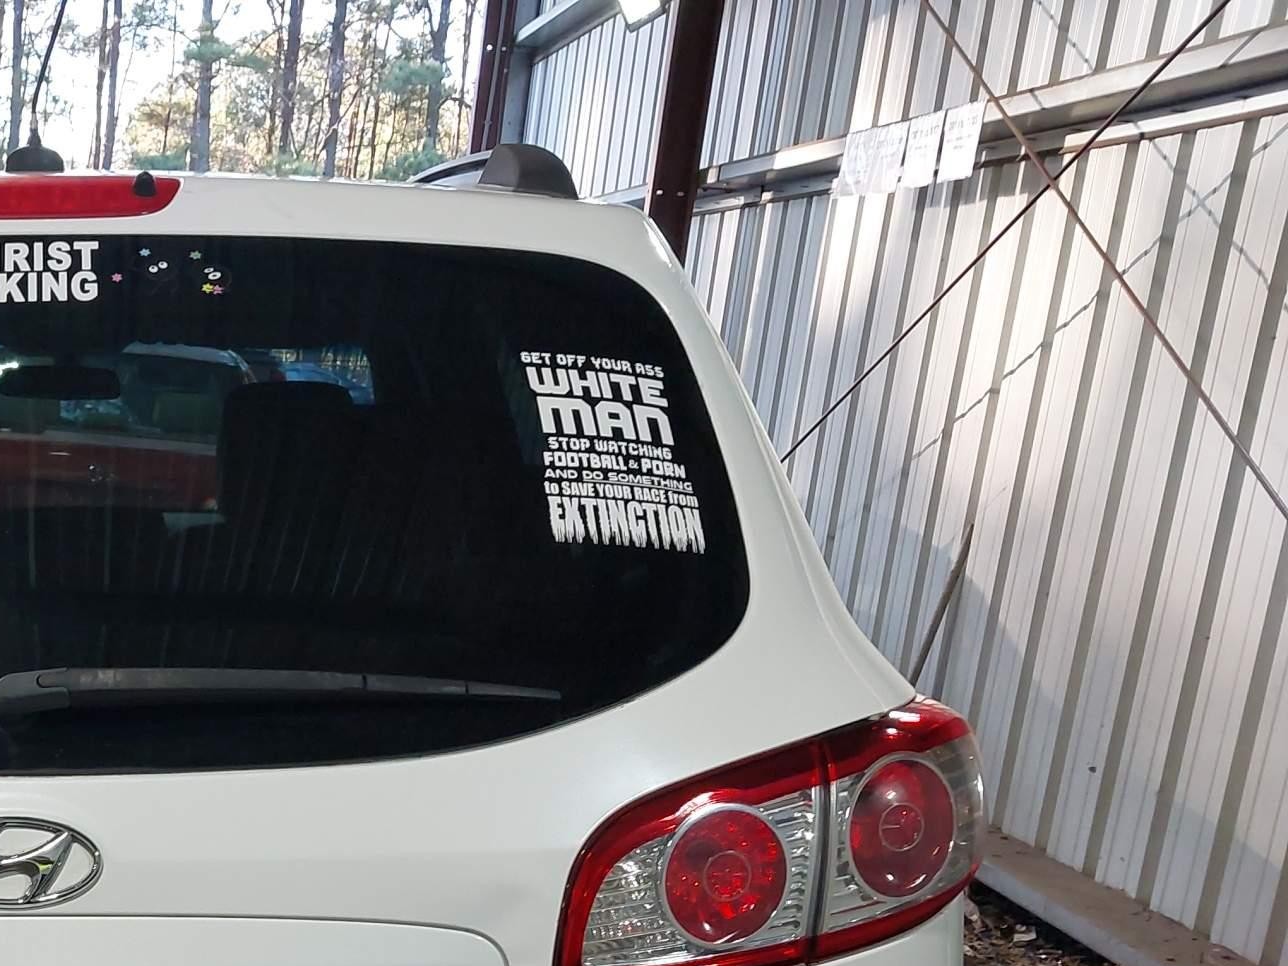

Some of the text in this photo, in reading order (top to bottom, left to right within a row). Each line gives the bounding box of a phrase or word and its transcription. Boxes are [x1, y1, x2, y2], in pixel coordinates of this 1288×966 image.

[520, 352, 665, 378] GET OFF YOUR ASS
[525, 366, 669, 408] WHITE
[536, 395, 675, 446] MAN
[547, 436, 673, 460] STOP WATCHING
[543, 451, 687, 479] FOOTBALL & PORN
[544, 468, 694, 492] AND DO SOMETHING
[544, 481, 699, 508] to SAVE YOUR RACE from
[548, 495, 707, 555] EXTINCTION
